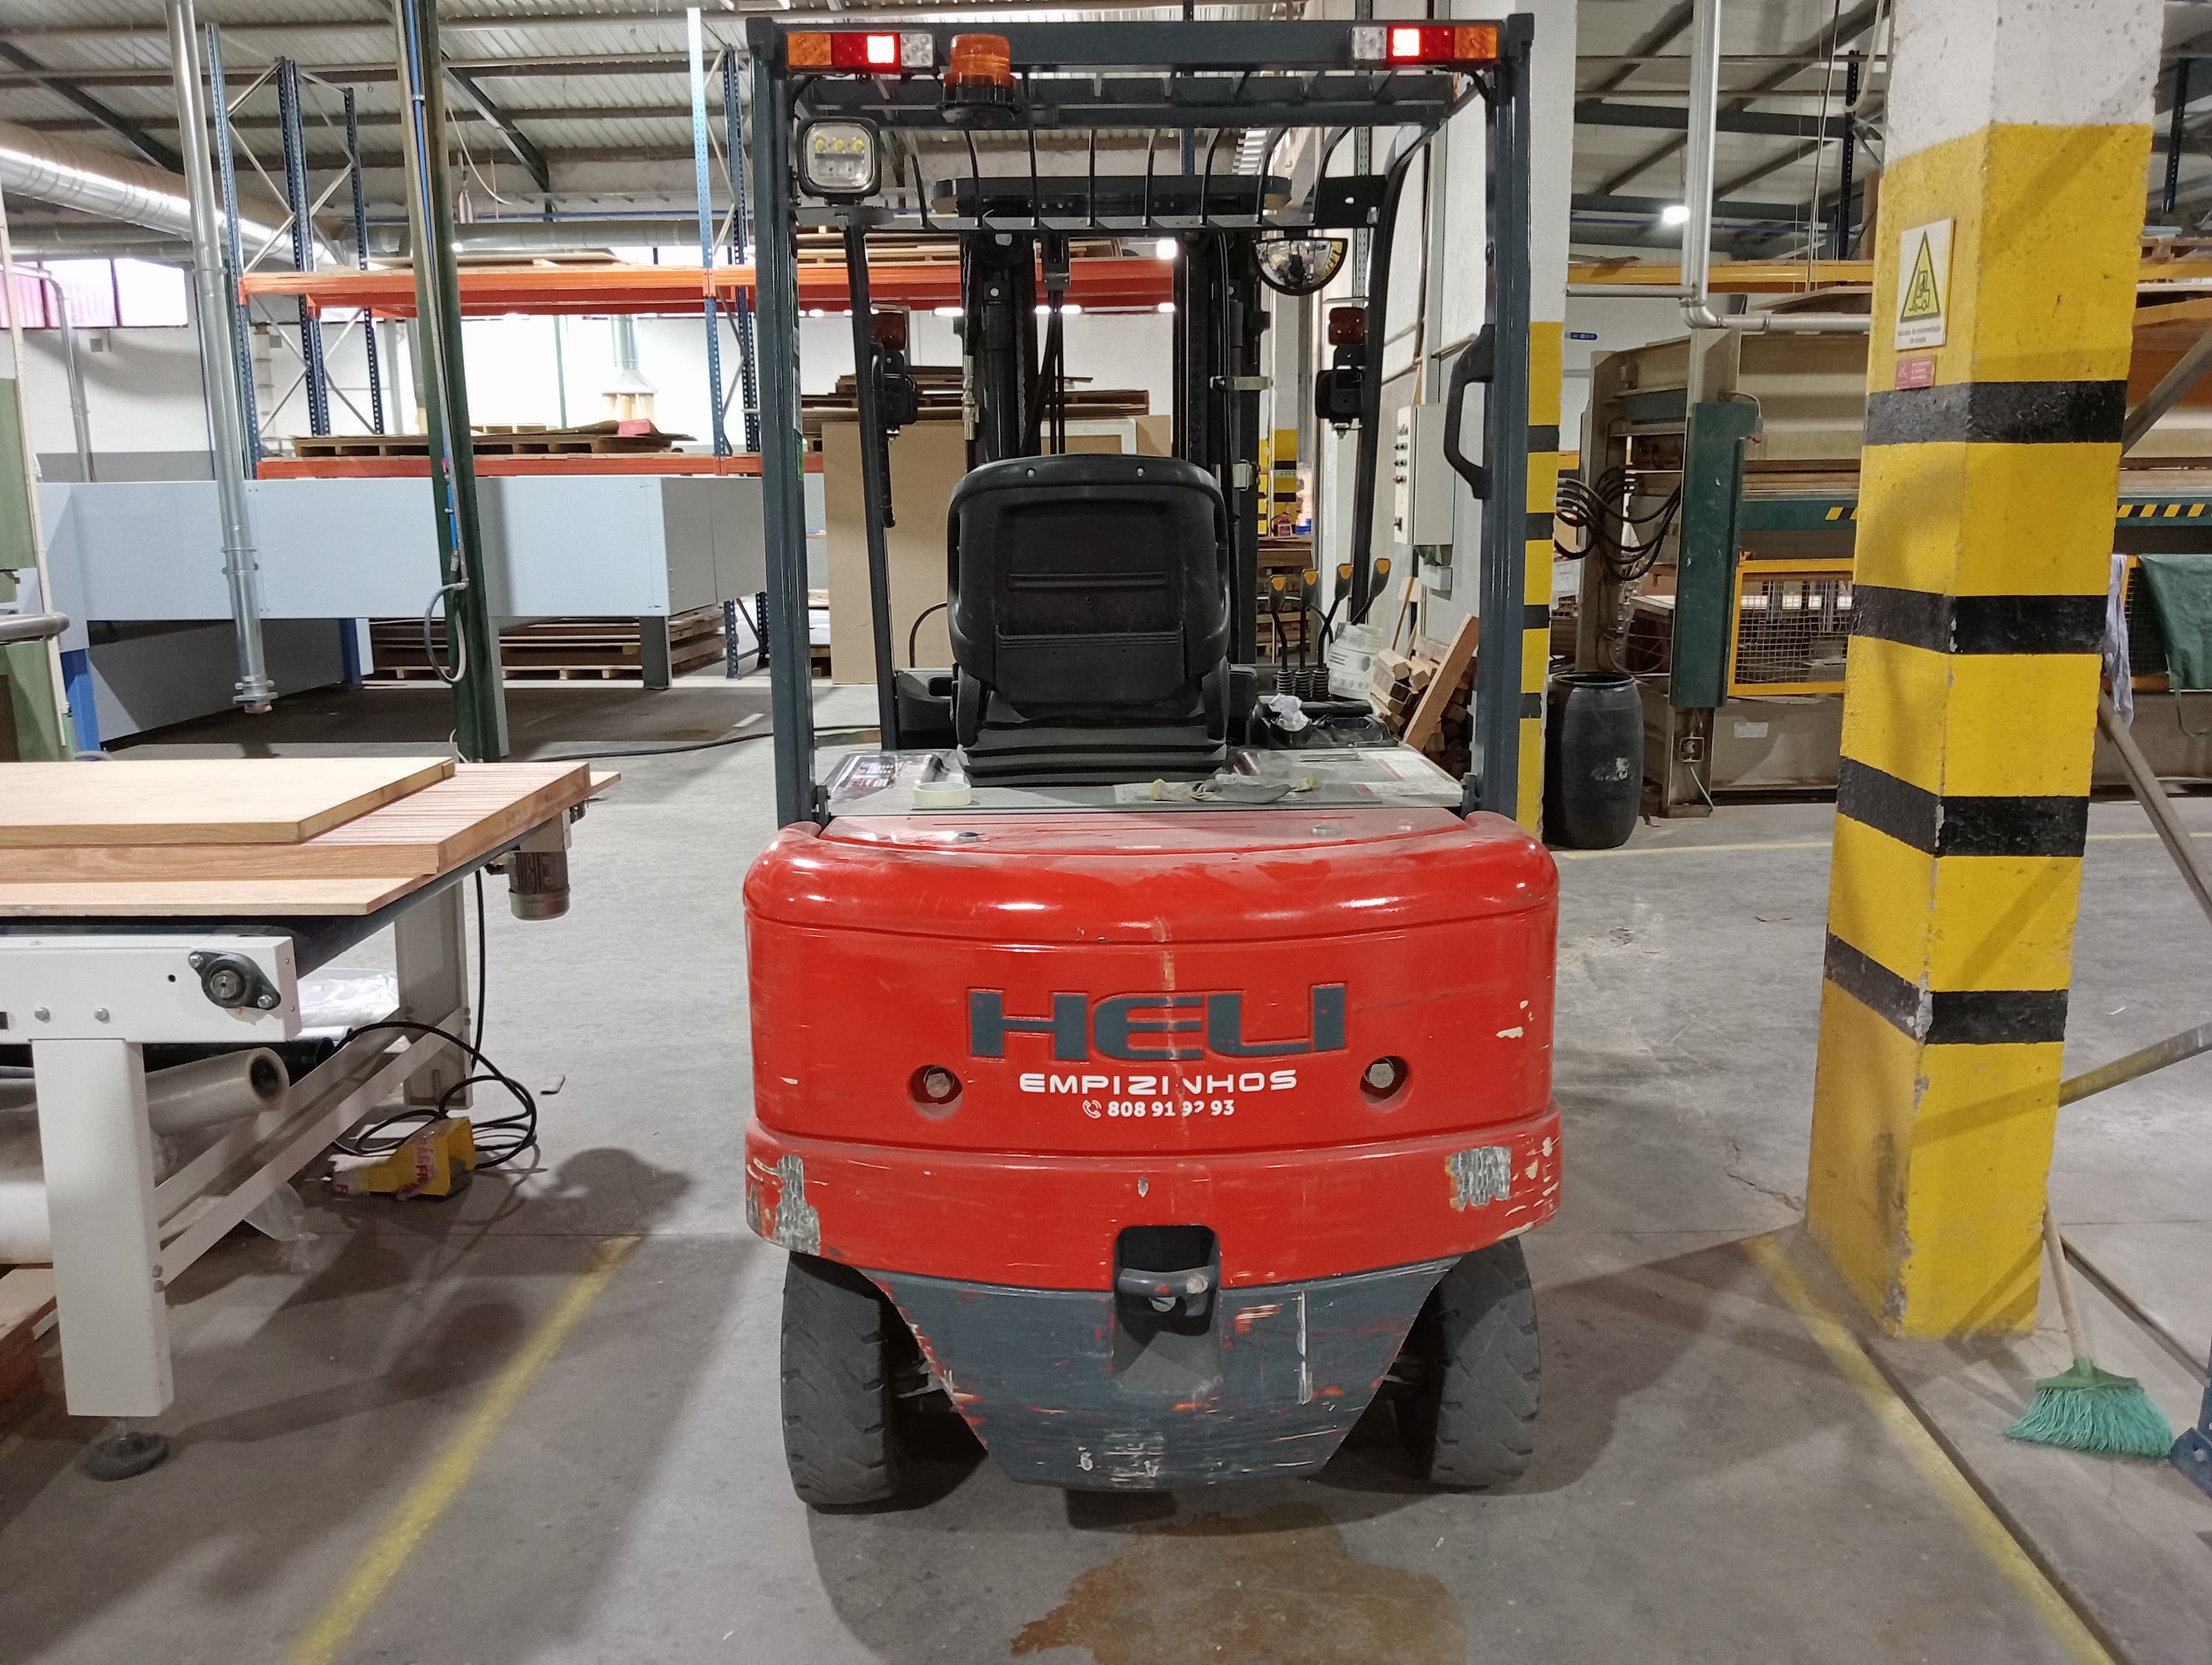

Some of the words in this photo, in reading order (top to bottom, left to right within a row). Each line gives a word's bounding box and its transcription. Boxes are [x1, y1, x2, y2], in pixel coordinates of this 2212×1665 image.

[969, 984, 1345, 1061] HELI
[1019, 1069, 1297, 1095] EMPIZINHOS
[1107, 1101, 1146, 1117] 808
[1151, 1101, 1176, 1117] 91
[1210, 1099, 1235, 1116] 93
